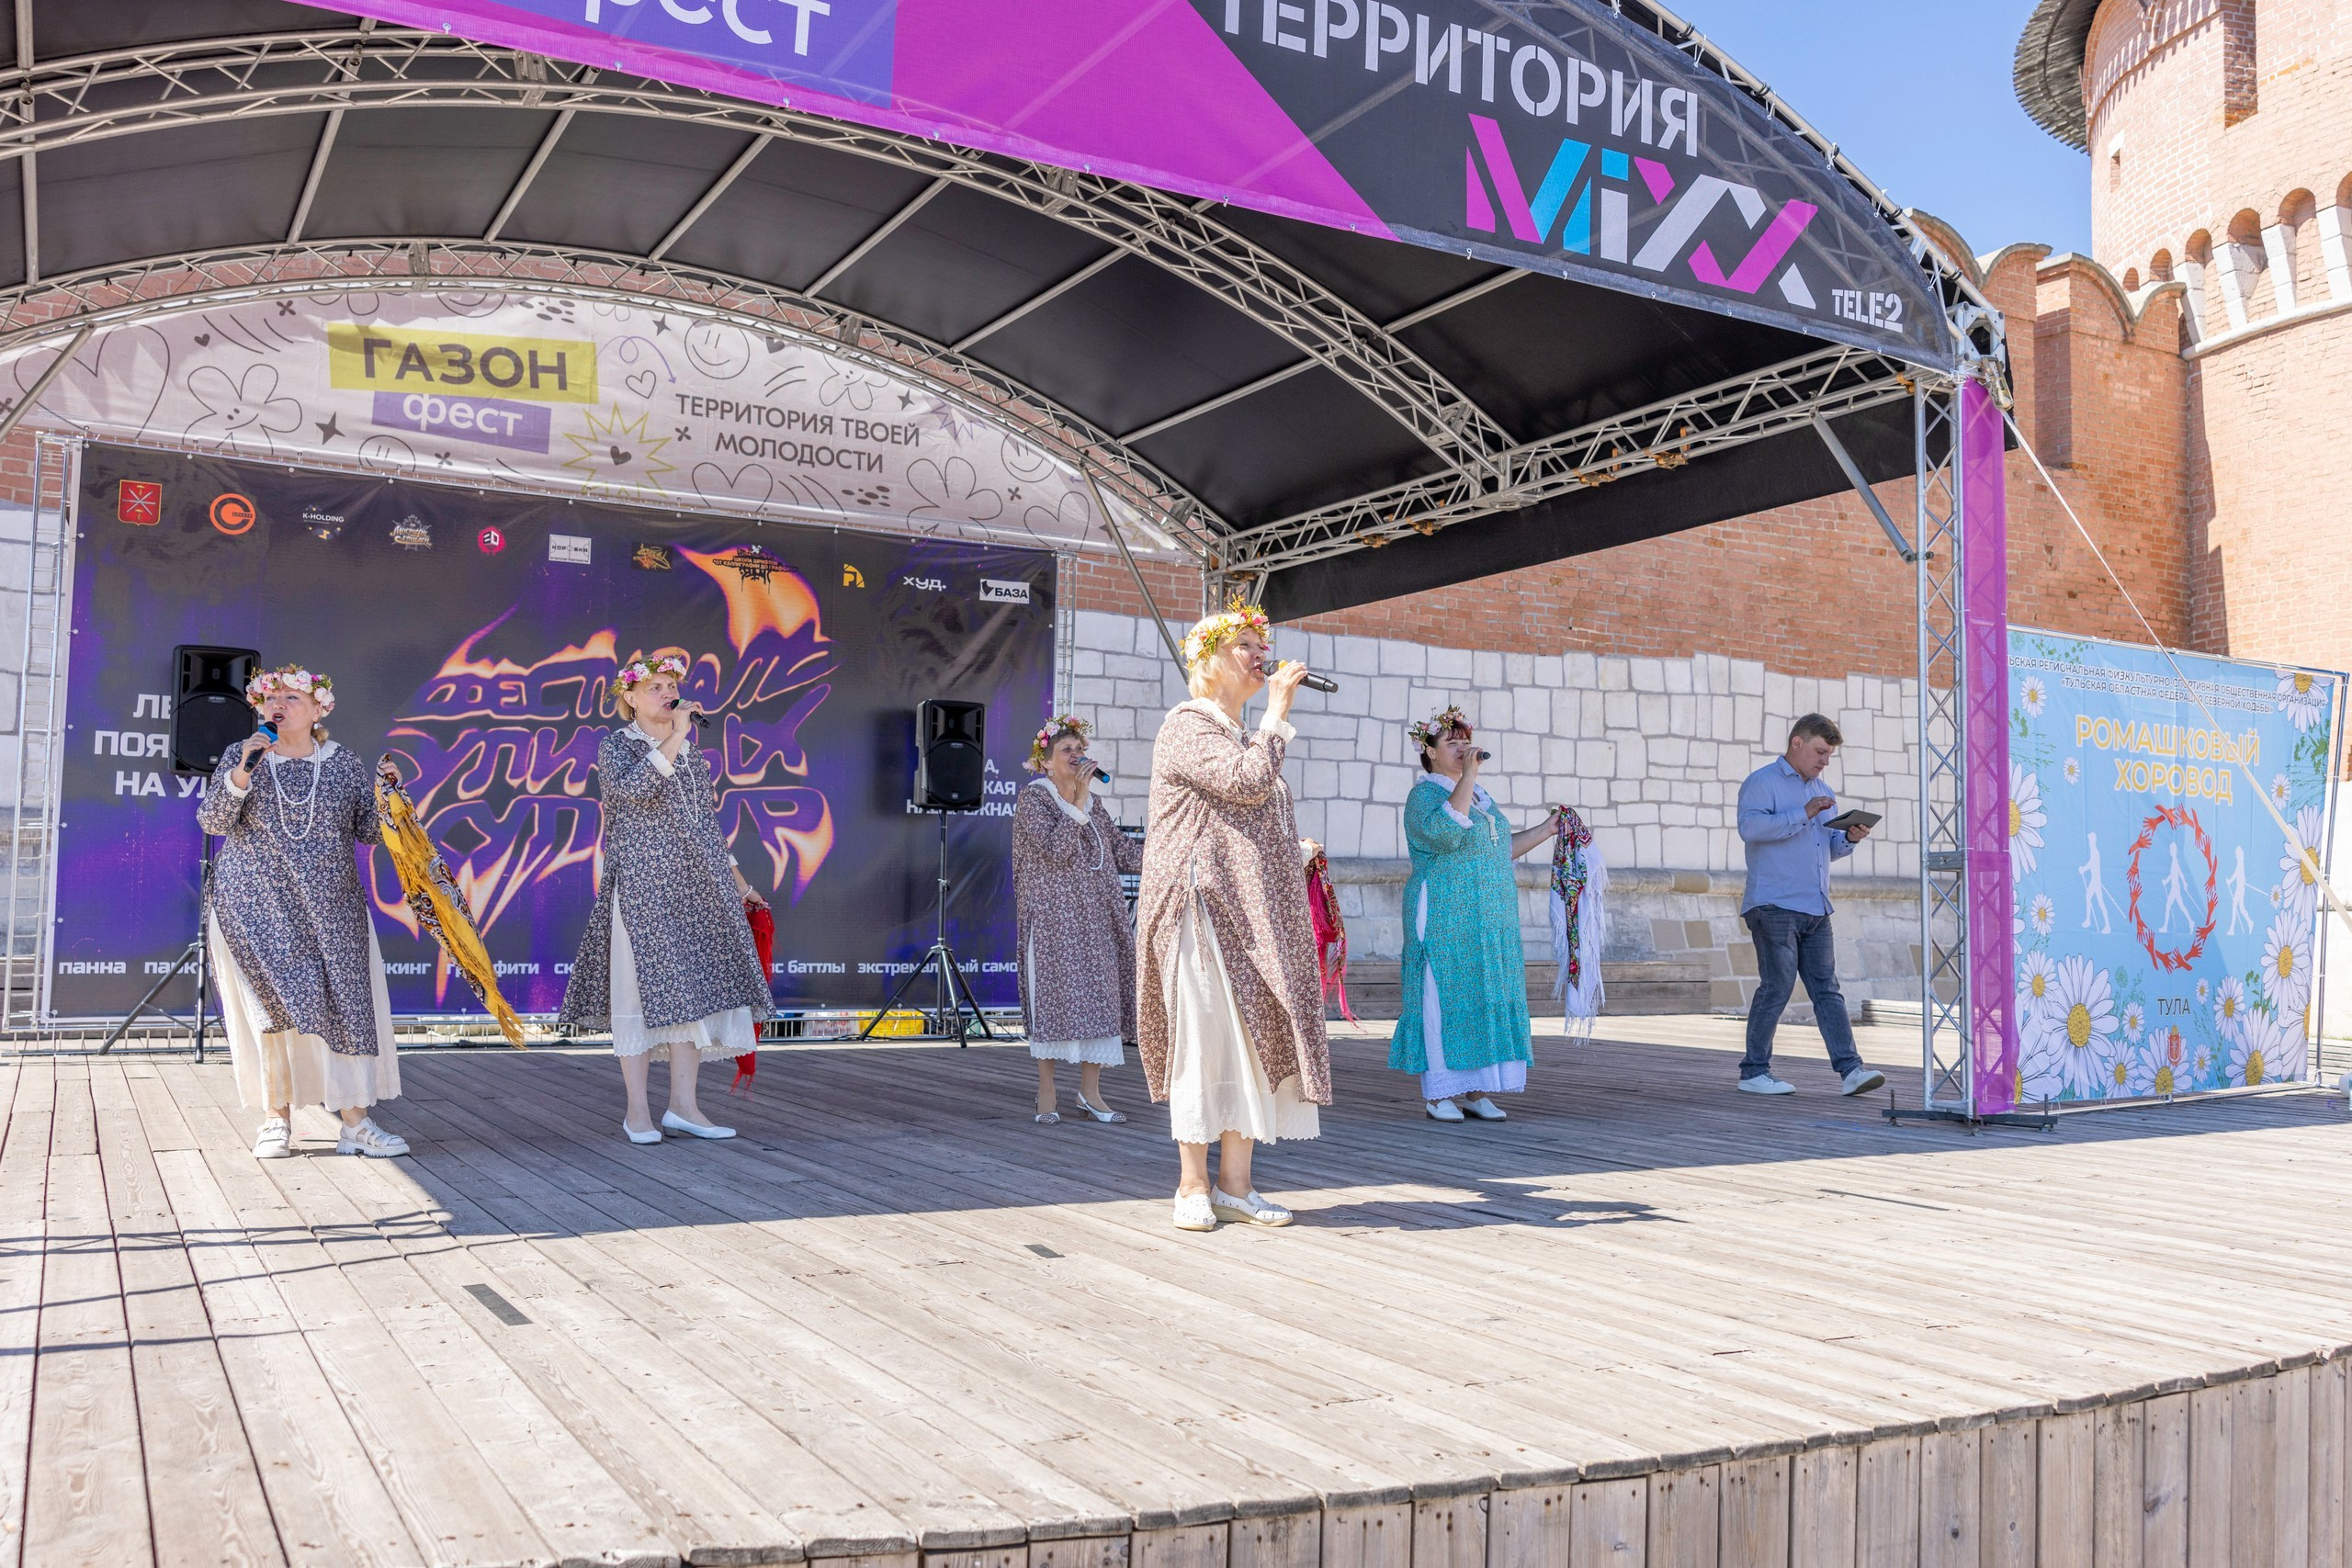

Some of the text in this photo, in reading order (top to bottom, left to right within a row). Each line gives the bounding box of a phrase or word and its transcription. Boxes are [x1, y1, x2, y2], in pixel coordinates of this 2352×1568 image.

[1831, 288, 1904, 333] TELE2
[362, 337, 568, 391] ГАЗОН
[402, 393, 523, 437] фест
[674, 393, 921, 447] ТЕРРИТОРИЯ ТВОЕЙ
[715, 433, 884, 474] МОЛОДОСТИ
[302, 512, 345, 524] K-HOLDING
[994, 587, 1029, 599] БАЗА
[2008, 655, 2038, 669] ЬСКАЯ
[2039, 660, 2106, 678] РЕГИОНАЛЬНАЯ
[2220, 686, 2277, 701] ОБЩЕСТВЕННАЯ
[2278, 693, 2326, 708] ОРГАНИЗАЦИЯ
[2109, 684, 2157, 698] ОБЛАСТНАЯ
[2204, 694, 2241, 708] СЕВЕРНОЙ
[2075, 715, 2260, 766] РОМАШКОВЫЙ
[115, 771, 166, 797] НА
[2114, 757, 2233, 806] ХОРОВОД
[59, 962, 126, 975] панна
[787, 959, 845, 974] баттлы
[2156, 998, 2191, 1017] ТУЛА
